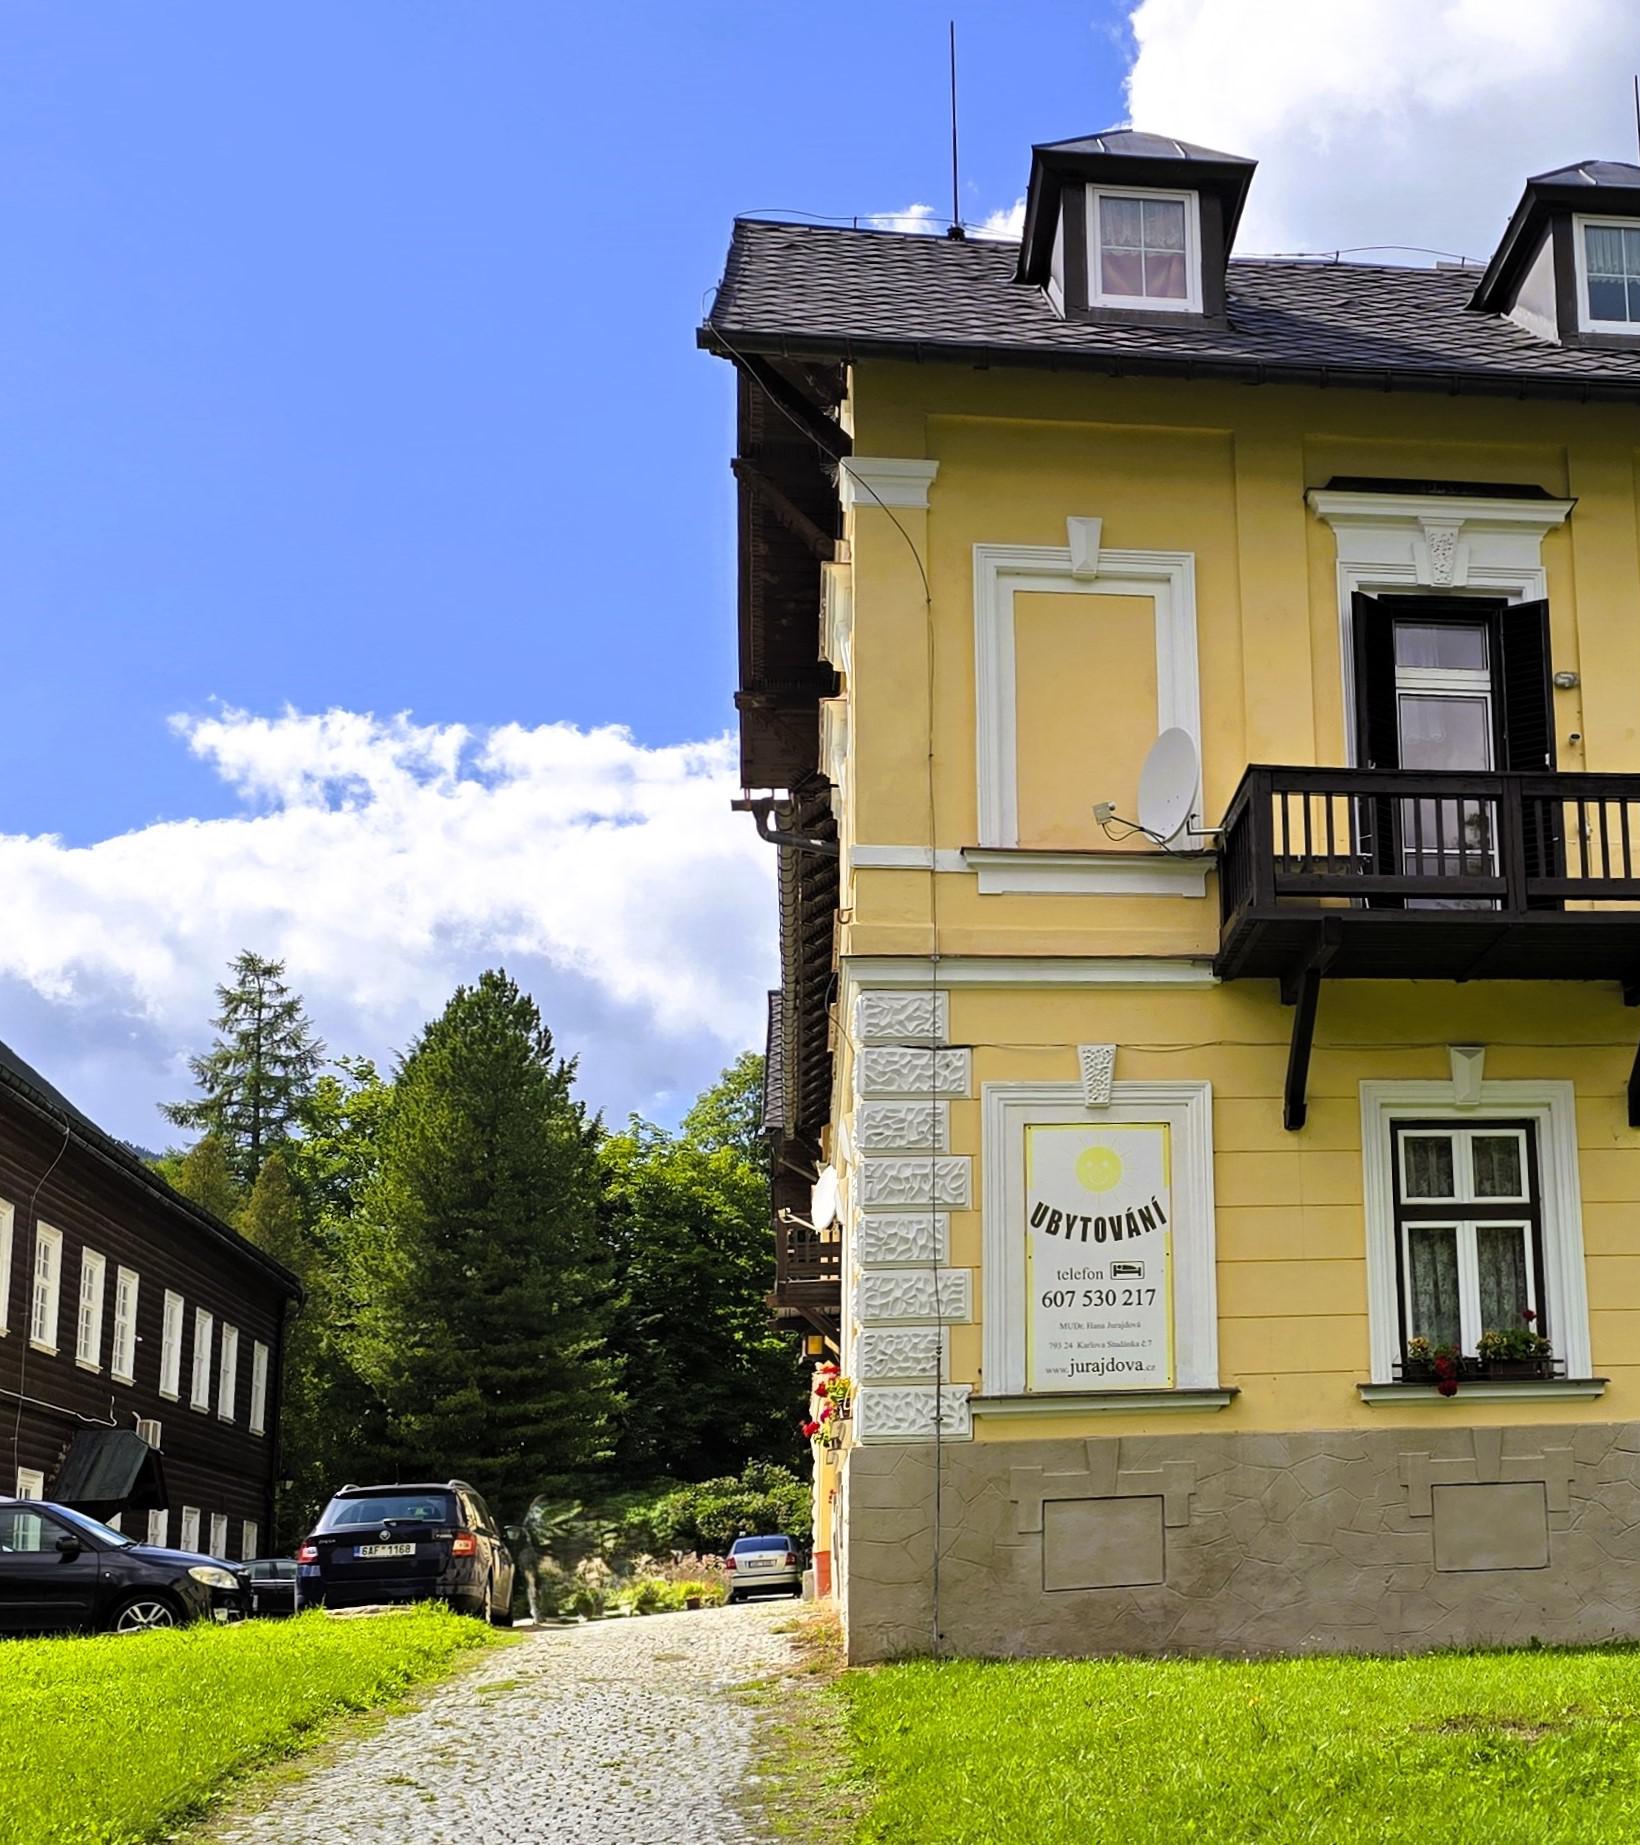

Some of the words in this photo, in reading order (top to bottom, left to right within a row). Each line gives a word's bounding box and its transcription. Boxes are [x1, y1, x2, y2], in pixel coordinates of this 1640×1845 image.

[1030, 1196, 1168, 1243] UBYTOVÁNÍ
[1057, 1267, 1104, 1281] telefon
[1041, 1290, 1076, 1308] 607
[1082, 1289, 1117, 1307] 530
[1122, 1288, 1156, 1306] 217
[1045, 1357, 1156, 1377] www.jurajdova.cz
[361, 1545, 379, 1556] 6AF
[387, 1543, 411, 1554] 1168
